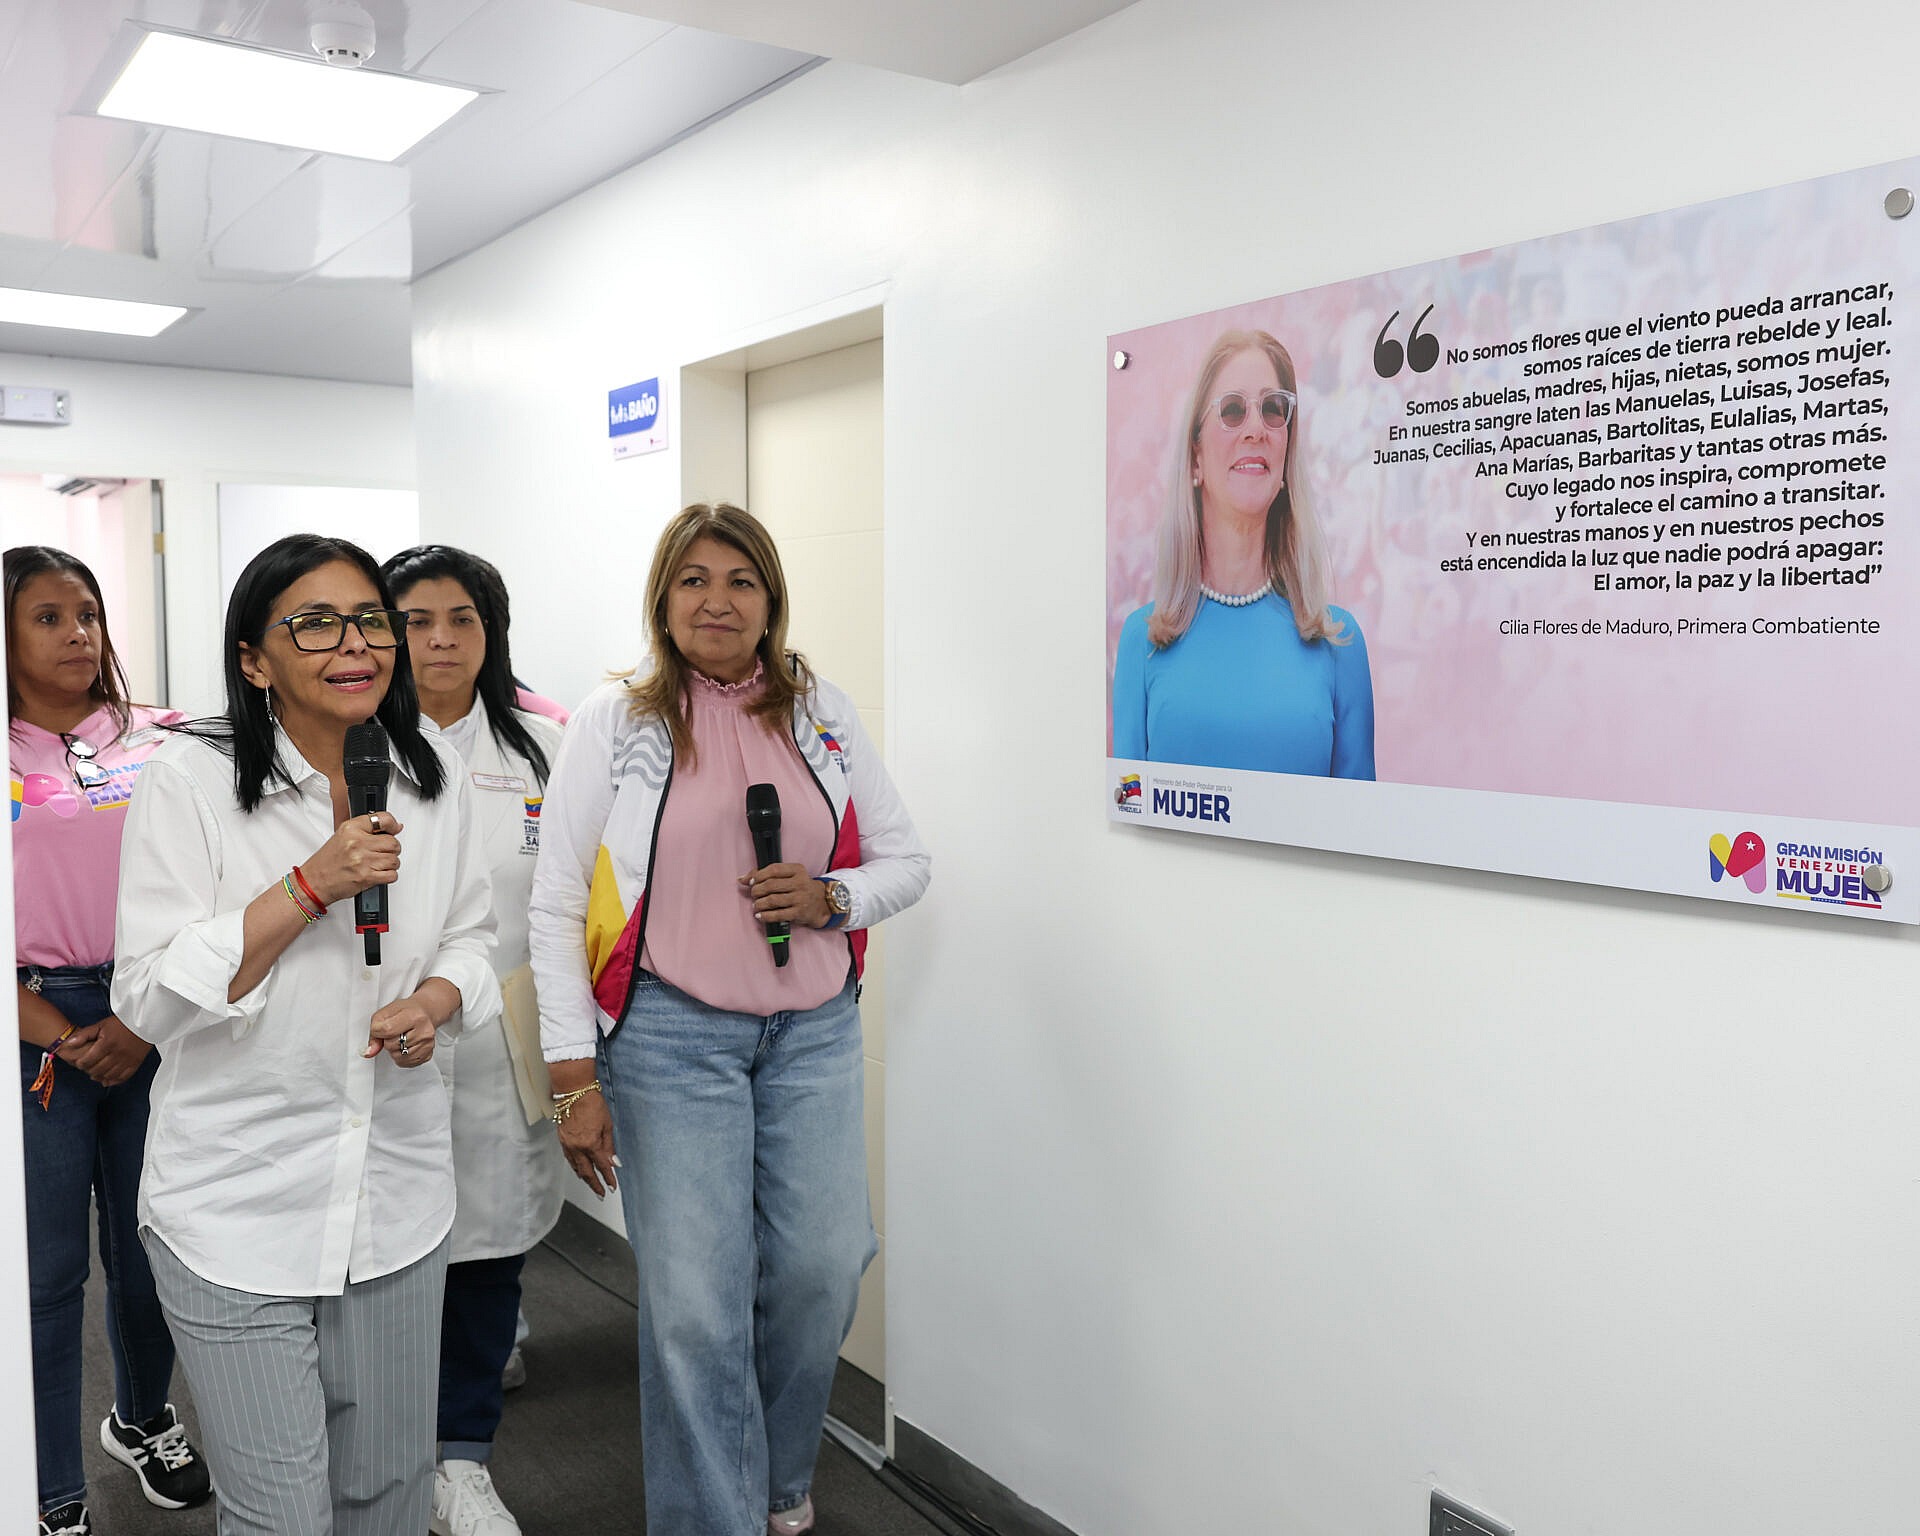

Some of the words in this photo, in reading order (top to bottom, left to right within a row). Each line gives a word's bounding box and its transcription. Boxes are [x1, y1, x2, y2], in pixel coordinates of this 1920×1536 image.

[1447, 348, 1469, 365] No
[1472, 340, 1528, 361] somos
[1531, 332, 1581, 352] flores
[1585, 325, 1621, 347] que
[1626, 317, 1642, 337] el
[1647, 310, 1710, 334] viento
[1716, 296, 1784, 328] pueda
[1790, 282, 1893, 312] arrancar,
[1523, 356, 1582, 377] somos
[1587, 347, 1641, 368] raíces
[1646, 340, 1671, 360] de
[1675, 334, 1730, 355] tierra
[1737, 318, 1820, 347] rebelde
[1825, 318, 1841, 340] y
[1846, 306, 1892, 332] leal.
[1406, 398, 1459, 417] Somos
[1462, 386, 1530, 409] abuelas,
[1535, 377, 1607, 400] madres,
[1612, 368, 1660, 393] hijas,
[1665, 361, 1732, 383] nietas,
[1737, 350, 1810, 374] somos
[1816, 337, 1891, 364] mujer.
[1389, 425, 1408, 441] En
[1412, 419, 1470, 439] nuestra
[1474, 412, 1532, 432] sangre
[1537, 406, 1580, 424] laten
[1586, 400, 1611, 418] las
[1616, 388, 1715, 415] Manuelas,
[1721, 379, 1792, 402] Luisas,
[1797, 367, 1890, 394] Josefas,
[1373, 448, 1429, 465] Juanas,
[1433, 437, 1496, 459] Cecilias,
[1499, 429, 1602, 455] Apacuanas,
[1607, 415, 1705, 441] Bartolitas,
[1711, 404, 1797, 430] Eulalias,
[1803, 398, 1888, 421] Martas,
[1475, 461, 1508, 478] Ana
[1513, 453, 1573, 475] Marías,
[1578, 443, 1675, 468] Barbaritas
[1679, 444, 1693, 464] y
[1696, 437, 1764, 458] tantas
[1769, 432, 1826, 451] otras
[1832, 422, 1887, 446] más.
[1505, 482, 1549, 501] Cuyo
[1553, 473, 1615, 498] legado
[1620, 474, 1655, 490] nos
[1660, 463, 1732, 489] inspira,
[1737, 453, 1886, 482] compromete
[1555, 505, 1567, 523] y
[1570, 497, 1653, 518] fortalece
[1658, 493, 1675, 512] el
[1680, 488, 1758, 511] camino
[1763, 491, 1776, 506] a
[1781, 480, 1885, 505] transitar.
[1466, 531, 1477, 548] Y
[1480, 533, 1501, 547] en
[1506, 528, 1581, 546] nuestras
[1585, 525, 1649, 542] manos
[1653, 524, 1666, 543] y
[1670, 522, 1695, 538] en
[1701, 516, 1794, 536] nuestros
[1800, 509, 1884, 536] pechos
[1440, 554, 1473, 572] está
[1477, 550, 1566, 571] encendida
[1572, 549, 1586, 567] la
[1592, 548, 1618, 566] luz
[1623, 550, 1660, 569] que
[1665, 542, 1722, 564] nadie
[1727, 539, 1789, 566] podrá
[1796, 540, 1883, 563] apagar:
[1594, 573, 1610, 591] El
[1615, 575, 1670, 593] amor,
[1676, 570, 1692, 589] la
[1698, 573, 1734, 593] paz
[1738, 573, 1752, 592] y
[1757, 567, 1775, 587] la
[1499, 619, 1529, 635] Cilia
[1533, 619, 1578, 635] Flores
[1581, 618, 1602, 635] de
[1606, 618, 1672, 637] Maduro,
[1677, 617, 1746, 634] Primera
[1752, 616, 1880, 634] Combatiente
[1153, 788, 1231, 824] MUJER
[1777, 842, 1821, 859] GRAN
[1824, 847, 1883, 865] MISIÓN
